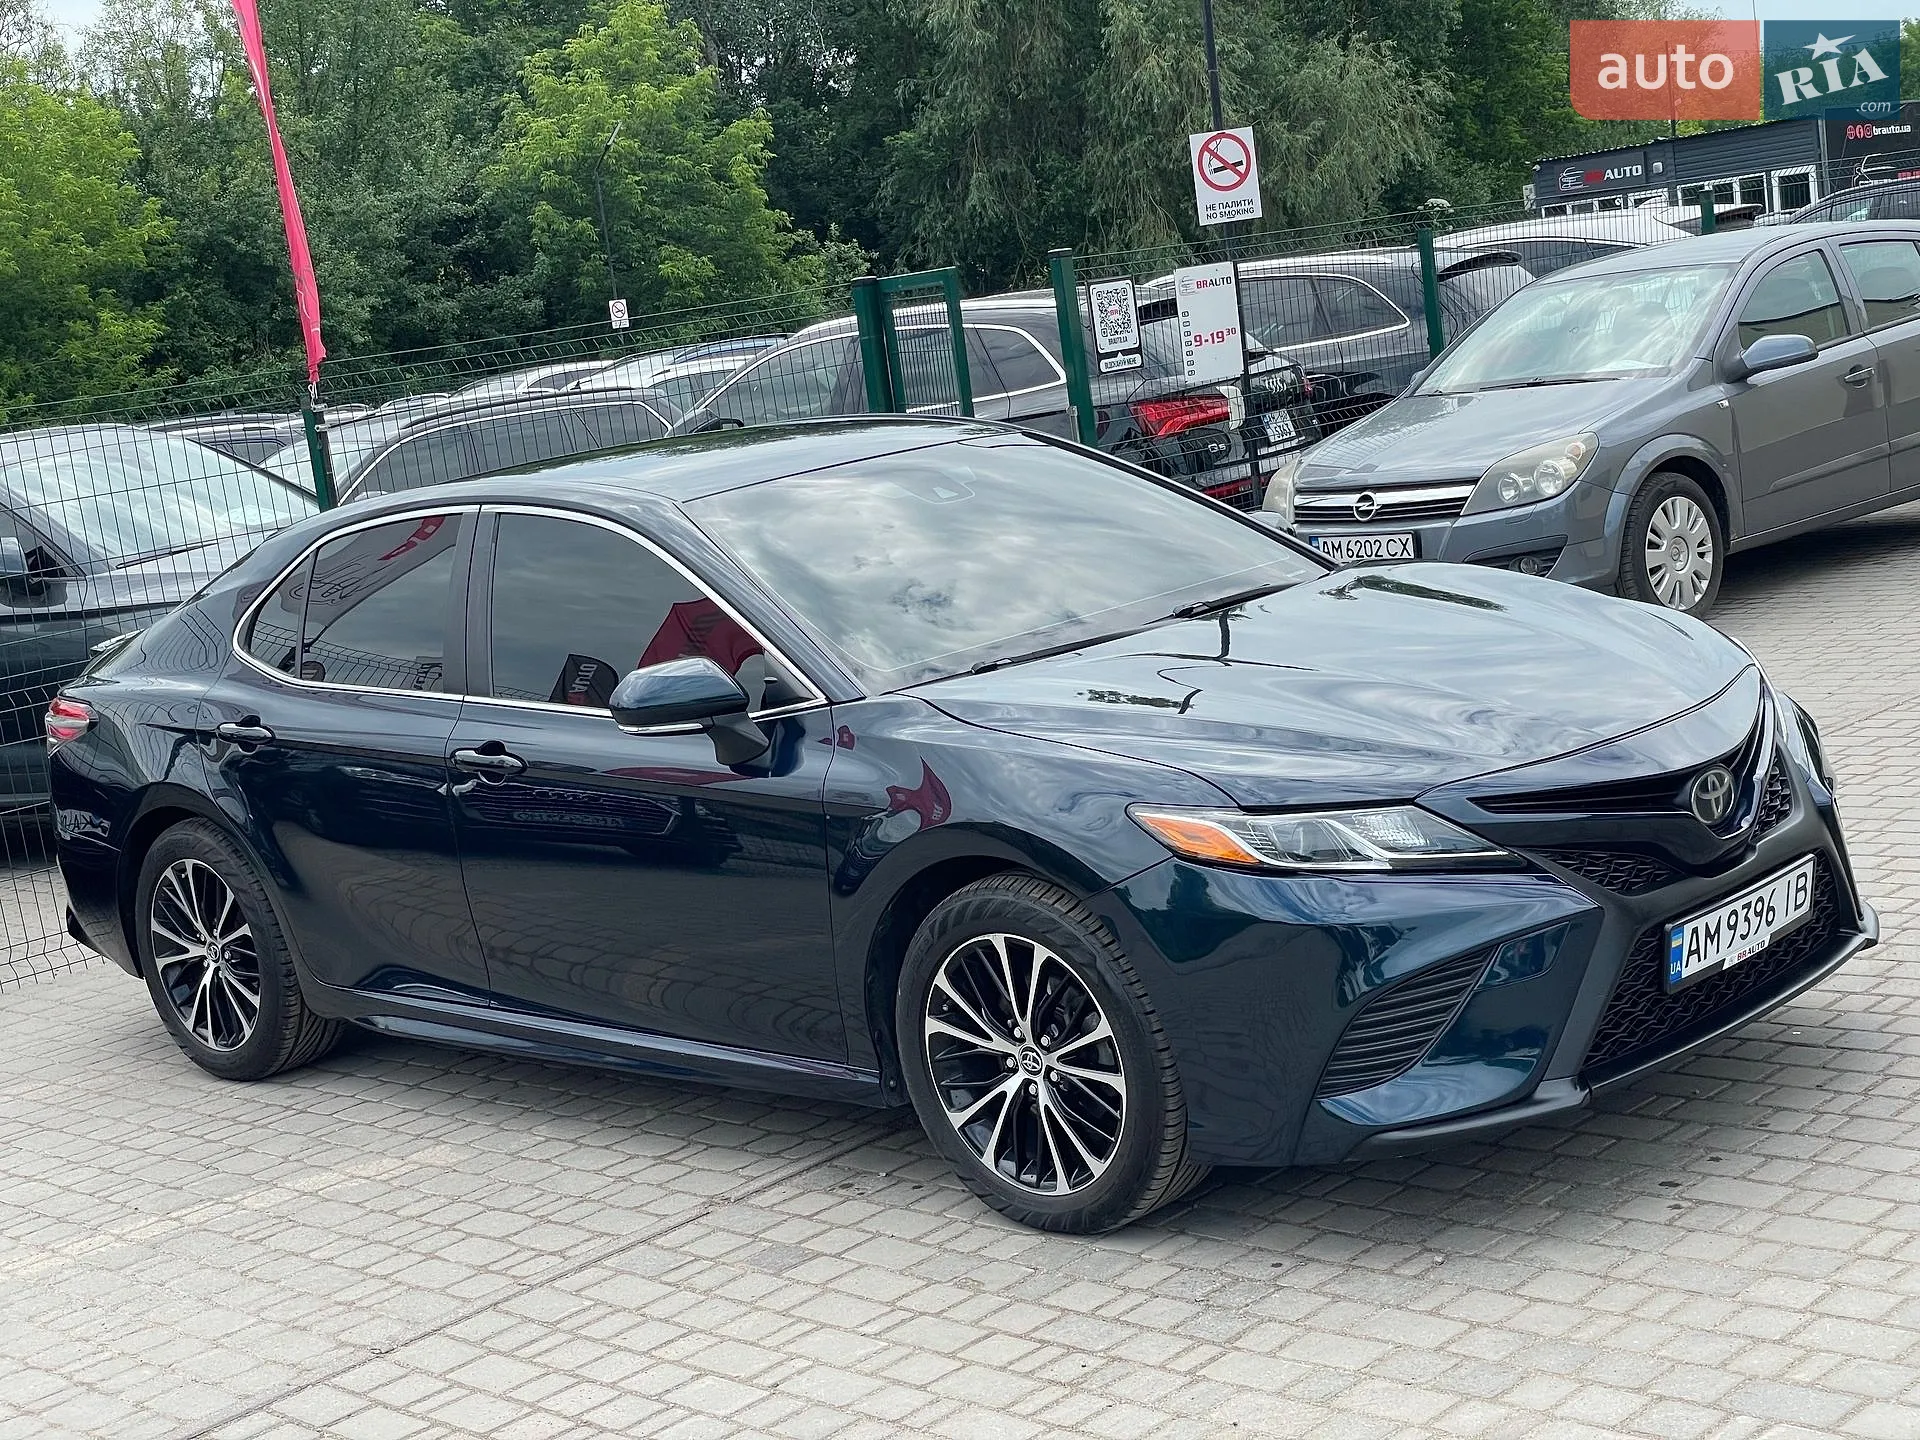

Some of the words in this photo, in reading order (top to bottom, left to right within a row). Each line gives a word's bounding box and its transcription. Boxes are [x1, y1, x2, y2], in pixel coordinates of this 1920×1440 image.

[1873, 124, 1911, 136] brauto.ua
[1205, 203, 1217, 212] НЕ
[1218, 198, 1254, 210] ПАЛИТИ
[1206, 212, 1218, 220] NO
[1220, 207, 1255, 218] SMOKING
[1196, 276, 1232, 289] BRAUTO
[1346, 539, 1384, 558] 6202
[1685, 915, 1722, 969] AM
[1726, 888, 1777, 949] 9396
[1670, 961, 1681, 975] UA
